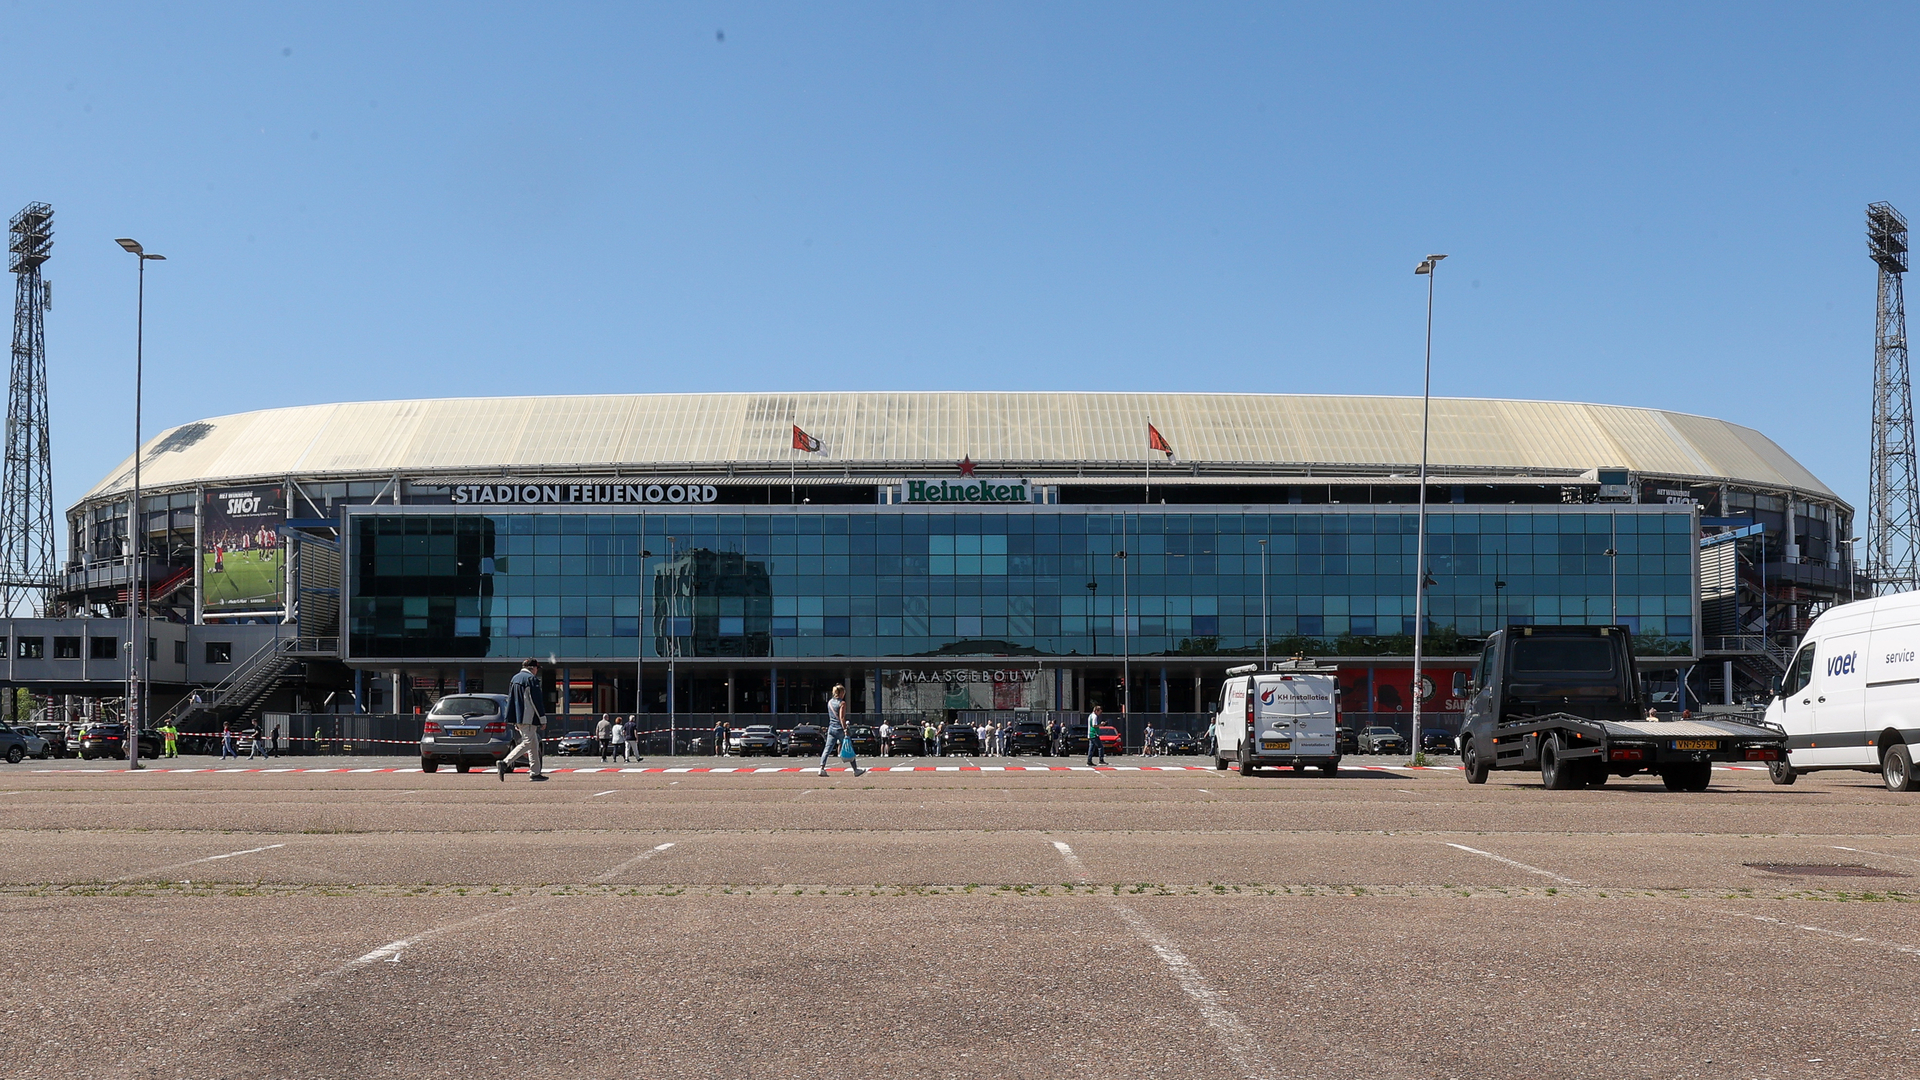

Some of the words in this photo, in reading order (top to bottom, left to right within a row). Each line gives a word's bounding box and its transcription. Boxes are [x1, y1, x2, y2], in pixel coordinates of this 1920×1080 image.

[455, 485, 560, 503] STADION
[569, 485, 718, 503] FEIJENOORD
[907, 480, 1026, 501] Heineken
[226, 497, 261, 514] SHOT
[1828, 651, 1857, 677] voet
[1885, 648, 1915, 664] service
[901, 671, 1037, 681] MAASGEBOUW
